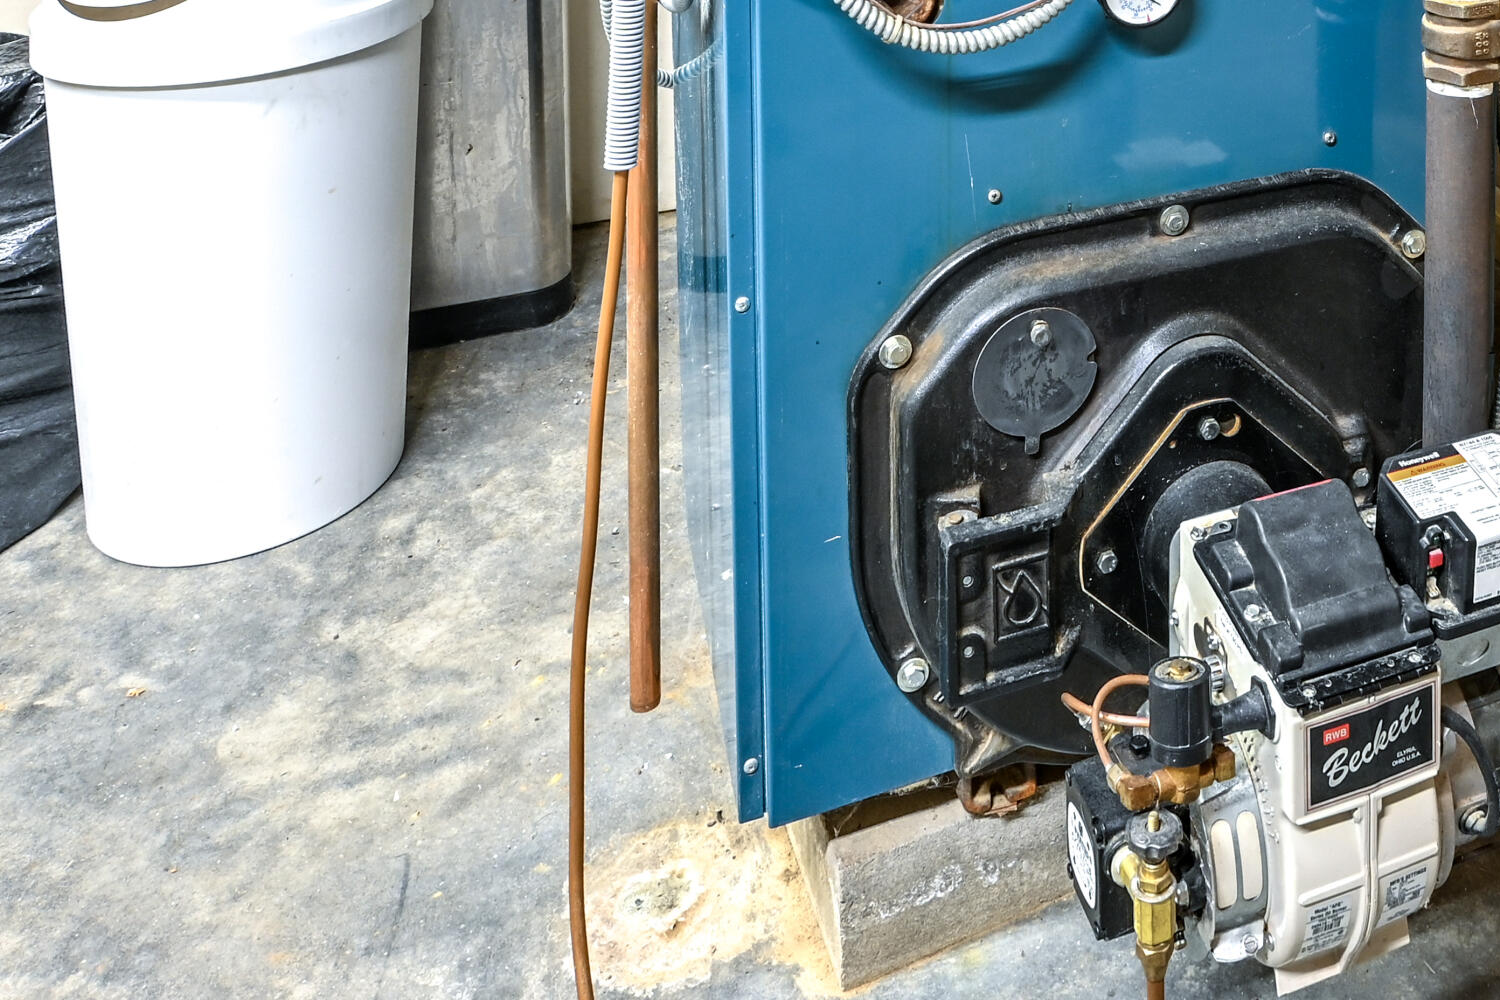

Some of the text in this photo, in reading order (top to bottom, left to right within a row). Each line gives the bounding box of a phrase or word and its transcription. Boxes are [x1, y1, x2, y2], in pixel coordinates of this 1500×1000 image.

[1398, 451, 1440, 467] Honeywell
[1323, 697, 1422, 787] Beckett
[1325, 728, 1347, 742] RWB
[1392, 757, 1405, 766] OHIO
